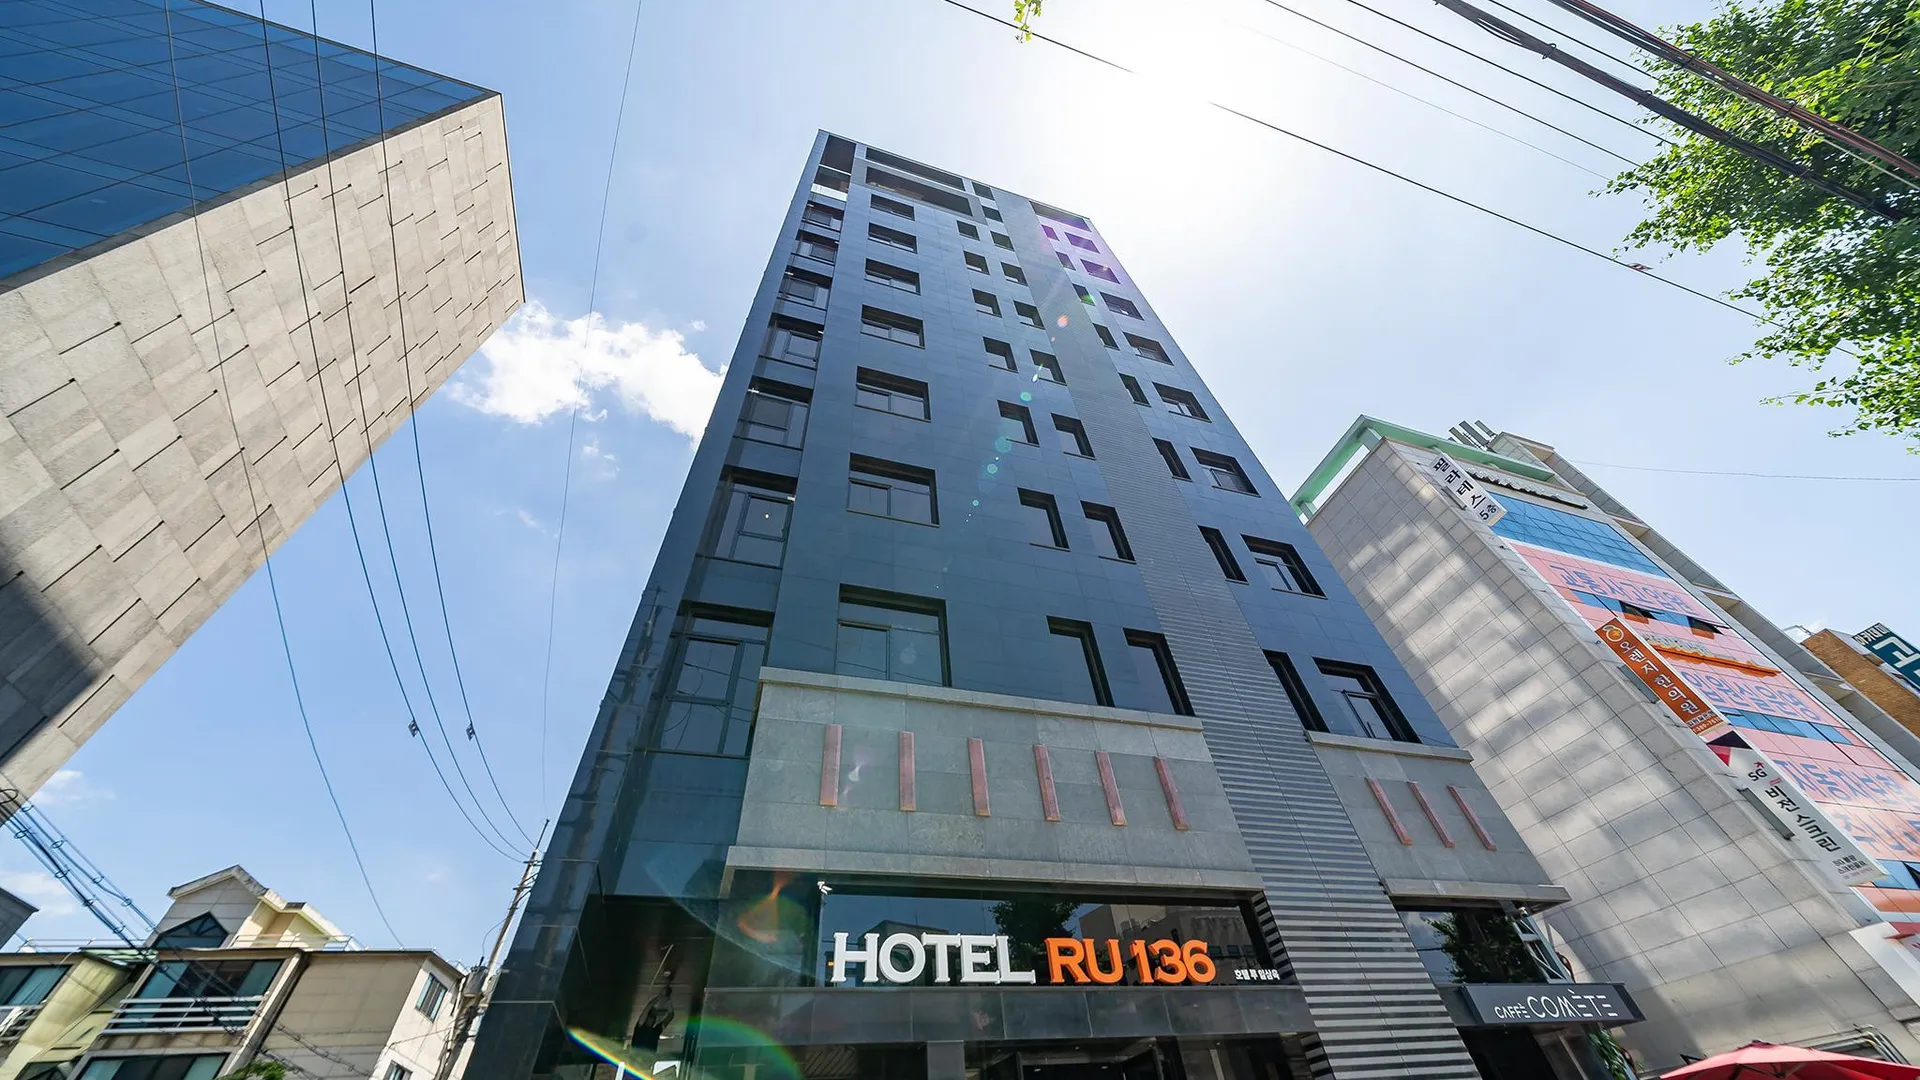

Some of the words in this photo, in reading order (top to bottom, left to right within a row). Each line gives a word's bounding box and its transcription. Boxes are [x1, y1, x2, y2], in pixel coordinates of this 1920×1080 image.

[1433, 457, 1486, 509] 필라테스
[1479, 504, 1497, 520] 5층
[1681, 671, 1820, 721] 입원실운영
[1748, 768, 1767, 781] SG
[1765, 785, 1800, 812] 비전
[1797, 814, 1841, 852] 스크린
[830, 932, 1036, 984] HOTEL
[1044, 937, 1123, 984] RU
[1130, 939, 1217, 984] 136
[1234, 969, 1250, 980] 호텔
[1258, 969, 1280, 980] 일삼육
[1494, 1003, 1531, 1019] CAFFÈ
[1527, 988, 1618, 1018] COMÈTE
